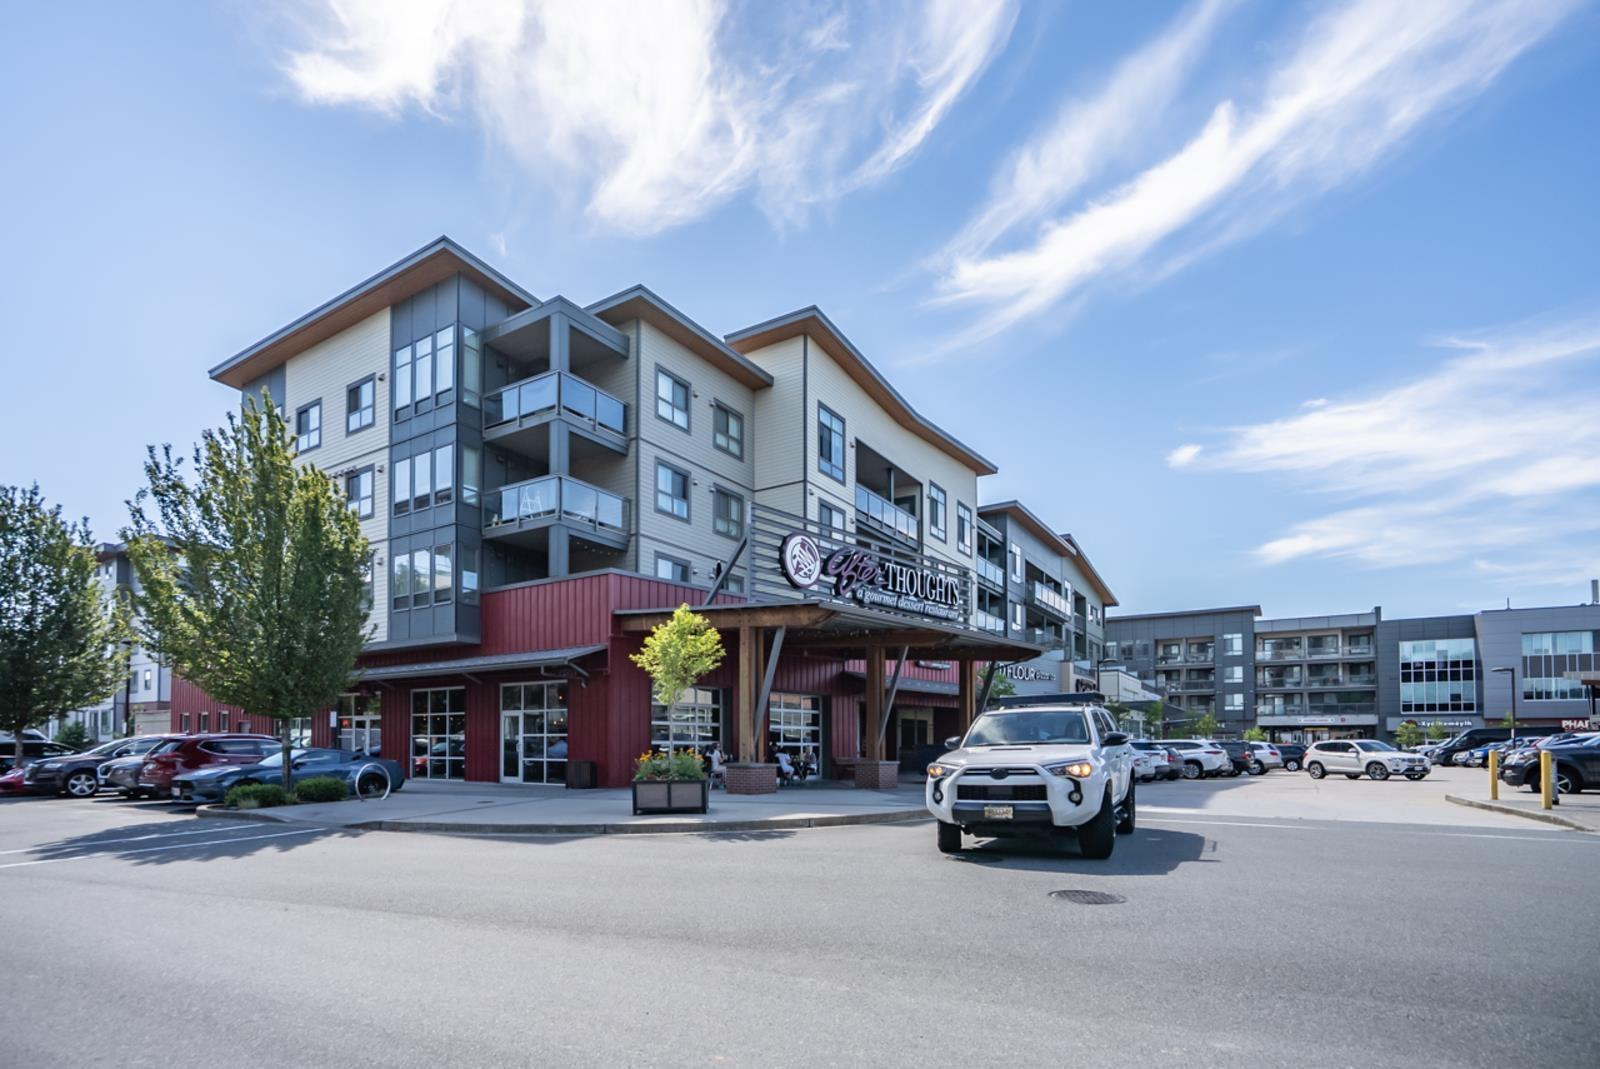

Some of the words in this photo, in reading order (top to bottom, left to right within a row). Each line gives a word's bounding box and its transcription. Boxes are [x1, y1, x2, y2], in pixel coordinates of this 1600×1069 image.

[885, 563, 960, 606] THOUGHTS
[864, 590, 898, 608] gourmet
[898, 594, 925, 613] dessert
[1007, 664, 1036, 680] FLOUR
